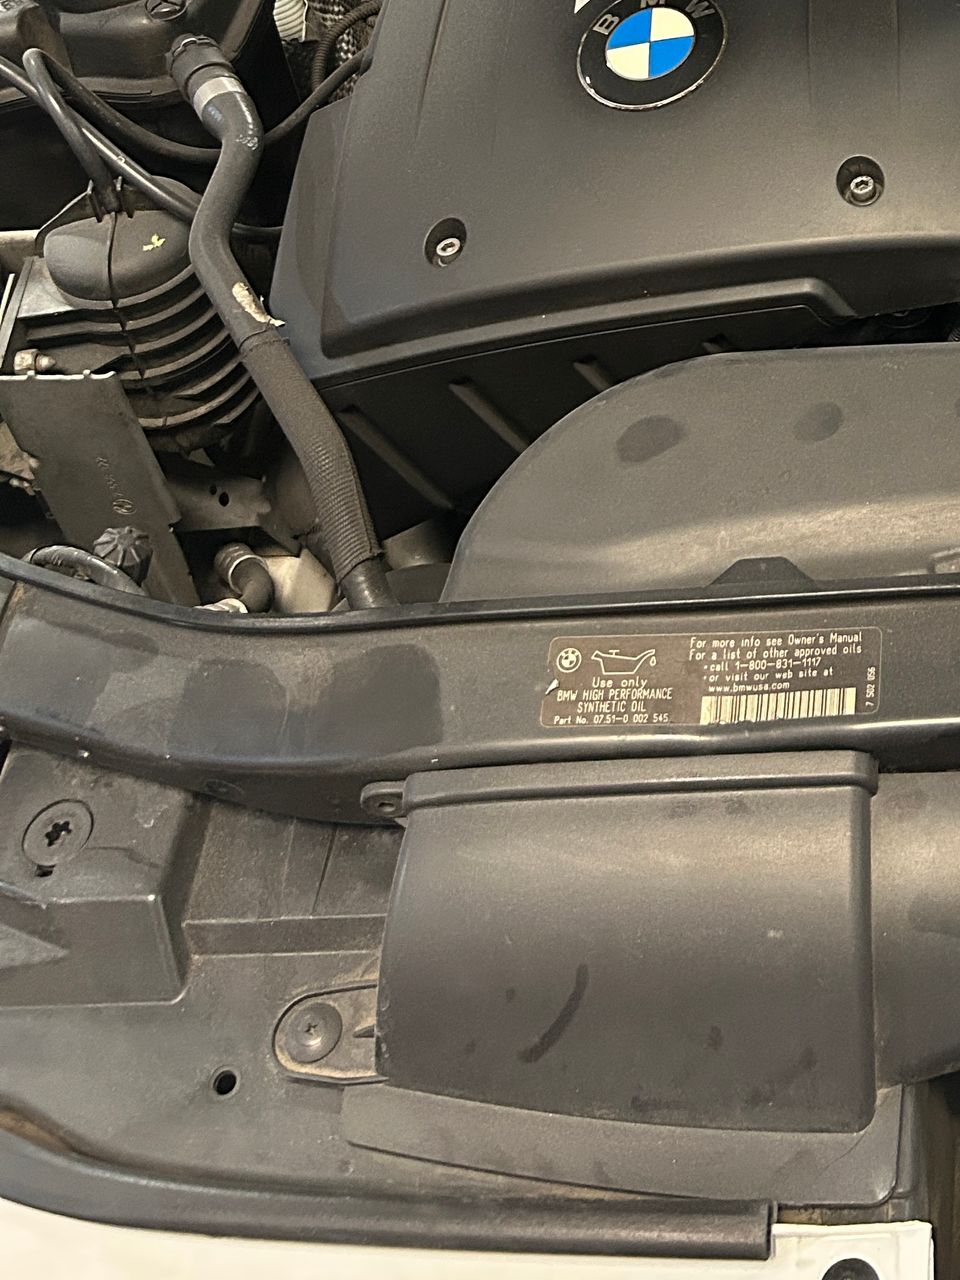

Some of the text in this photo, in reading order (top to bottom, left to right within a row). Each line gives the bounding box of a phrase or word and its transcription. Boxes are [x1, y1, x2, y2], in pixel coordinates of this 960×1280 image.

[690, 632, 862, 649] For more info see Owner's Manual
[688, 643, 862, 661] For a list of other approved oils
[710, 657, 822, 672] call 1-800-831-1117
[709, 674, 719, 682] or
[725, 672, 748, 681] visit
[775, 670, 793, 679] web
[798, 668, 818, 677] site
[823, 667, 833, 676] at
[592, 676, 647, 691] Use only
[708, 682, 790, 692] www.bmwusa.com
[557, 688, 673, 702] BMW HIGH PERFORMANCE
[577, 701, 646, 713] SYNTHETIC OIL
[554, 715, 572, 724] Part
[576, 715, 588, 724] No.
[593, 714, 628, 724] 07.51-0
[633, 714, 648, 723] 002
